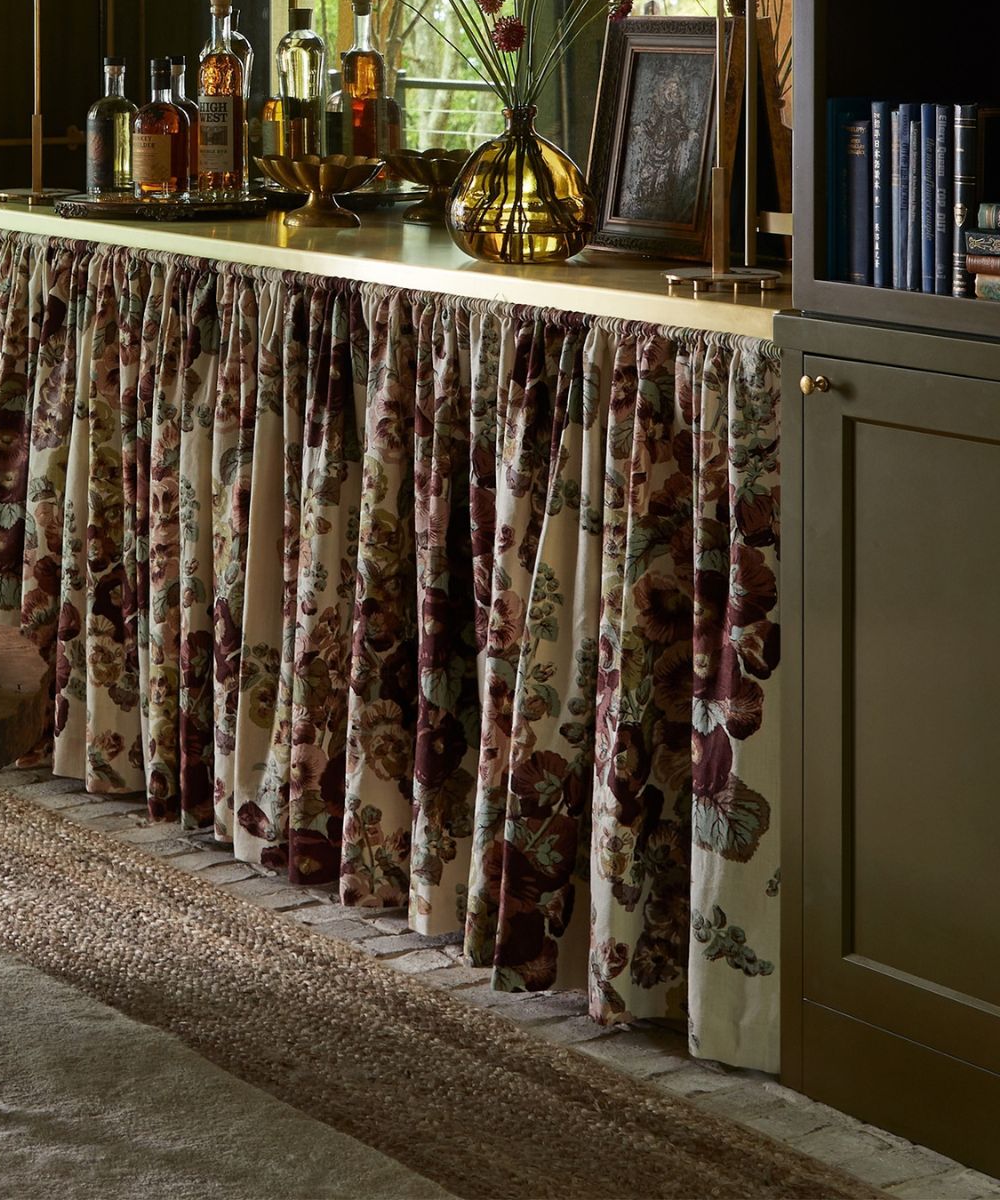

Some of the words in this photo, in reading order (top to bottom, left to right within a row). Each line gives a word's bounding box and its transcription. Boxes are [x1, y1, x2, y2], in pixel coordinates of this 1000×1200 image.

[199, 102, 227, 112] HIGH
[200, 113, 228, 123] WEST
[937, 114, 947, 144] Ellery
[937, 147, 946, 177] Queen
